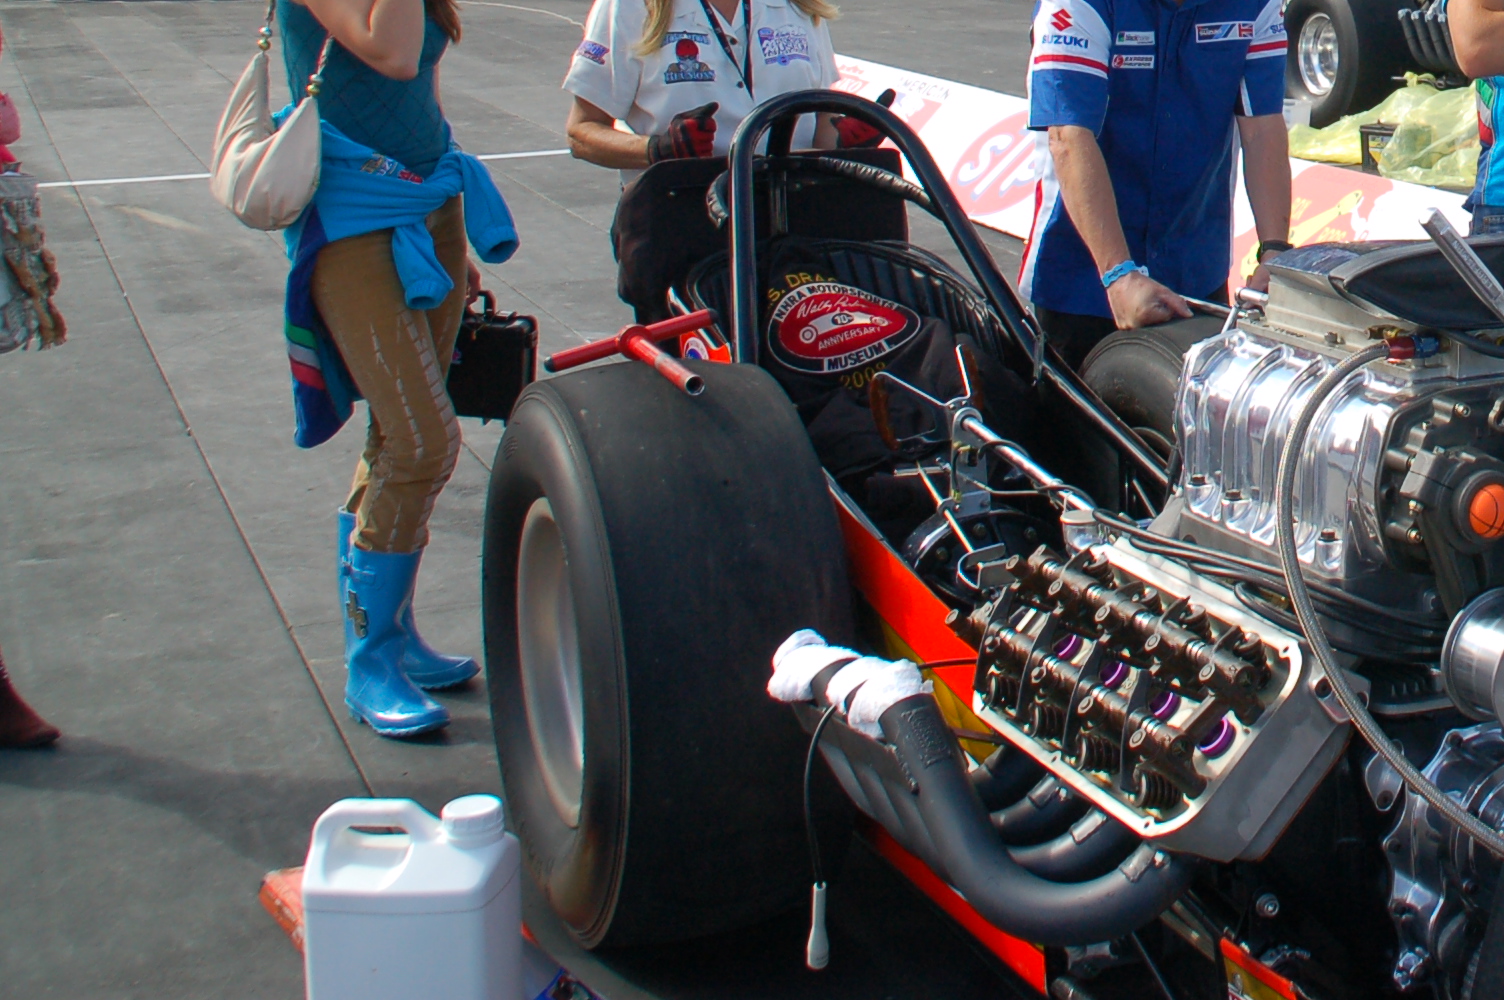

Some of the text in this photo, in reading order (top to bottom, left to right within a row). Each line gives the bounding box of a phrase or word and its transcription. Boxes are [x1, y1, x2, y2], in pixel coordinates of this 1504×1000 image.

[1041, 34, 1090, 49] SUZUKI
[774, 284, 898, 323] NHRA MOTORSPORTS
[818, 326, 881, 350] ANNIVERSARY
[827, 341, 887, 371] MUSEUM
